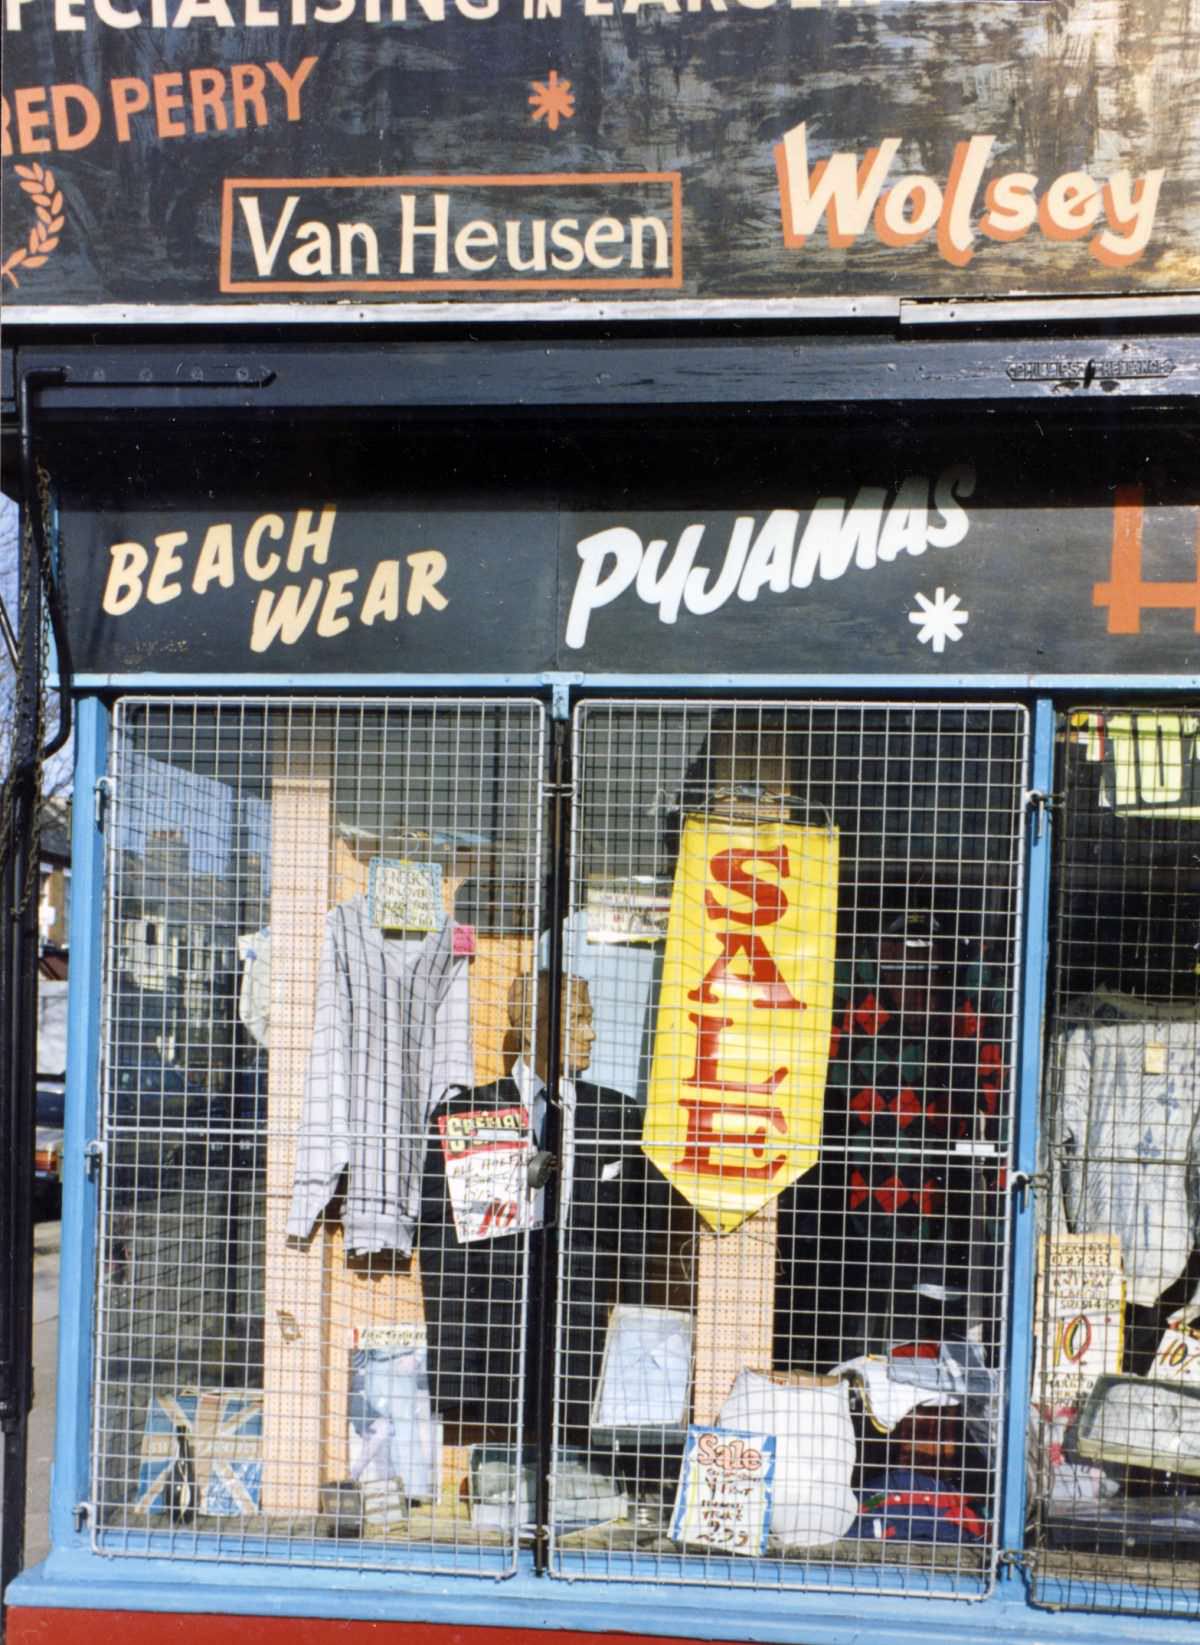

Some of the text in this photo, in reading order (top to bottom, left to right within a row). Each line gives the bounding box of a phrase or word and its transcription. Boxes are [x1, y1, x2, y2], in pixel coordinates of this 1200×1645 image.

[110, 56, 320, 143] PERRY
[239, 192, 669, 276] Van Heusen
[773, 120, 1165, 268] Wolsey
[102, 504, 338, 617] BEACH
[249, 549, 450, 653] WEAR
[674, 845, 807, 1180] SALE
[697, 1432, 763, 1471] Sale
